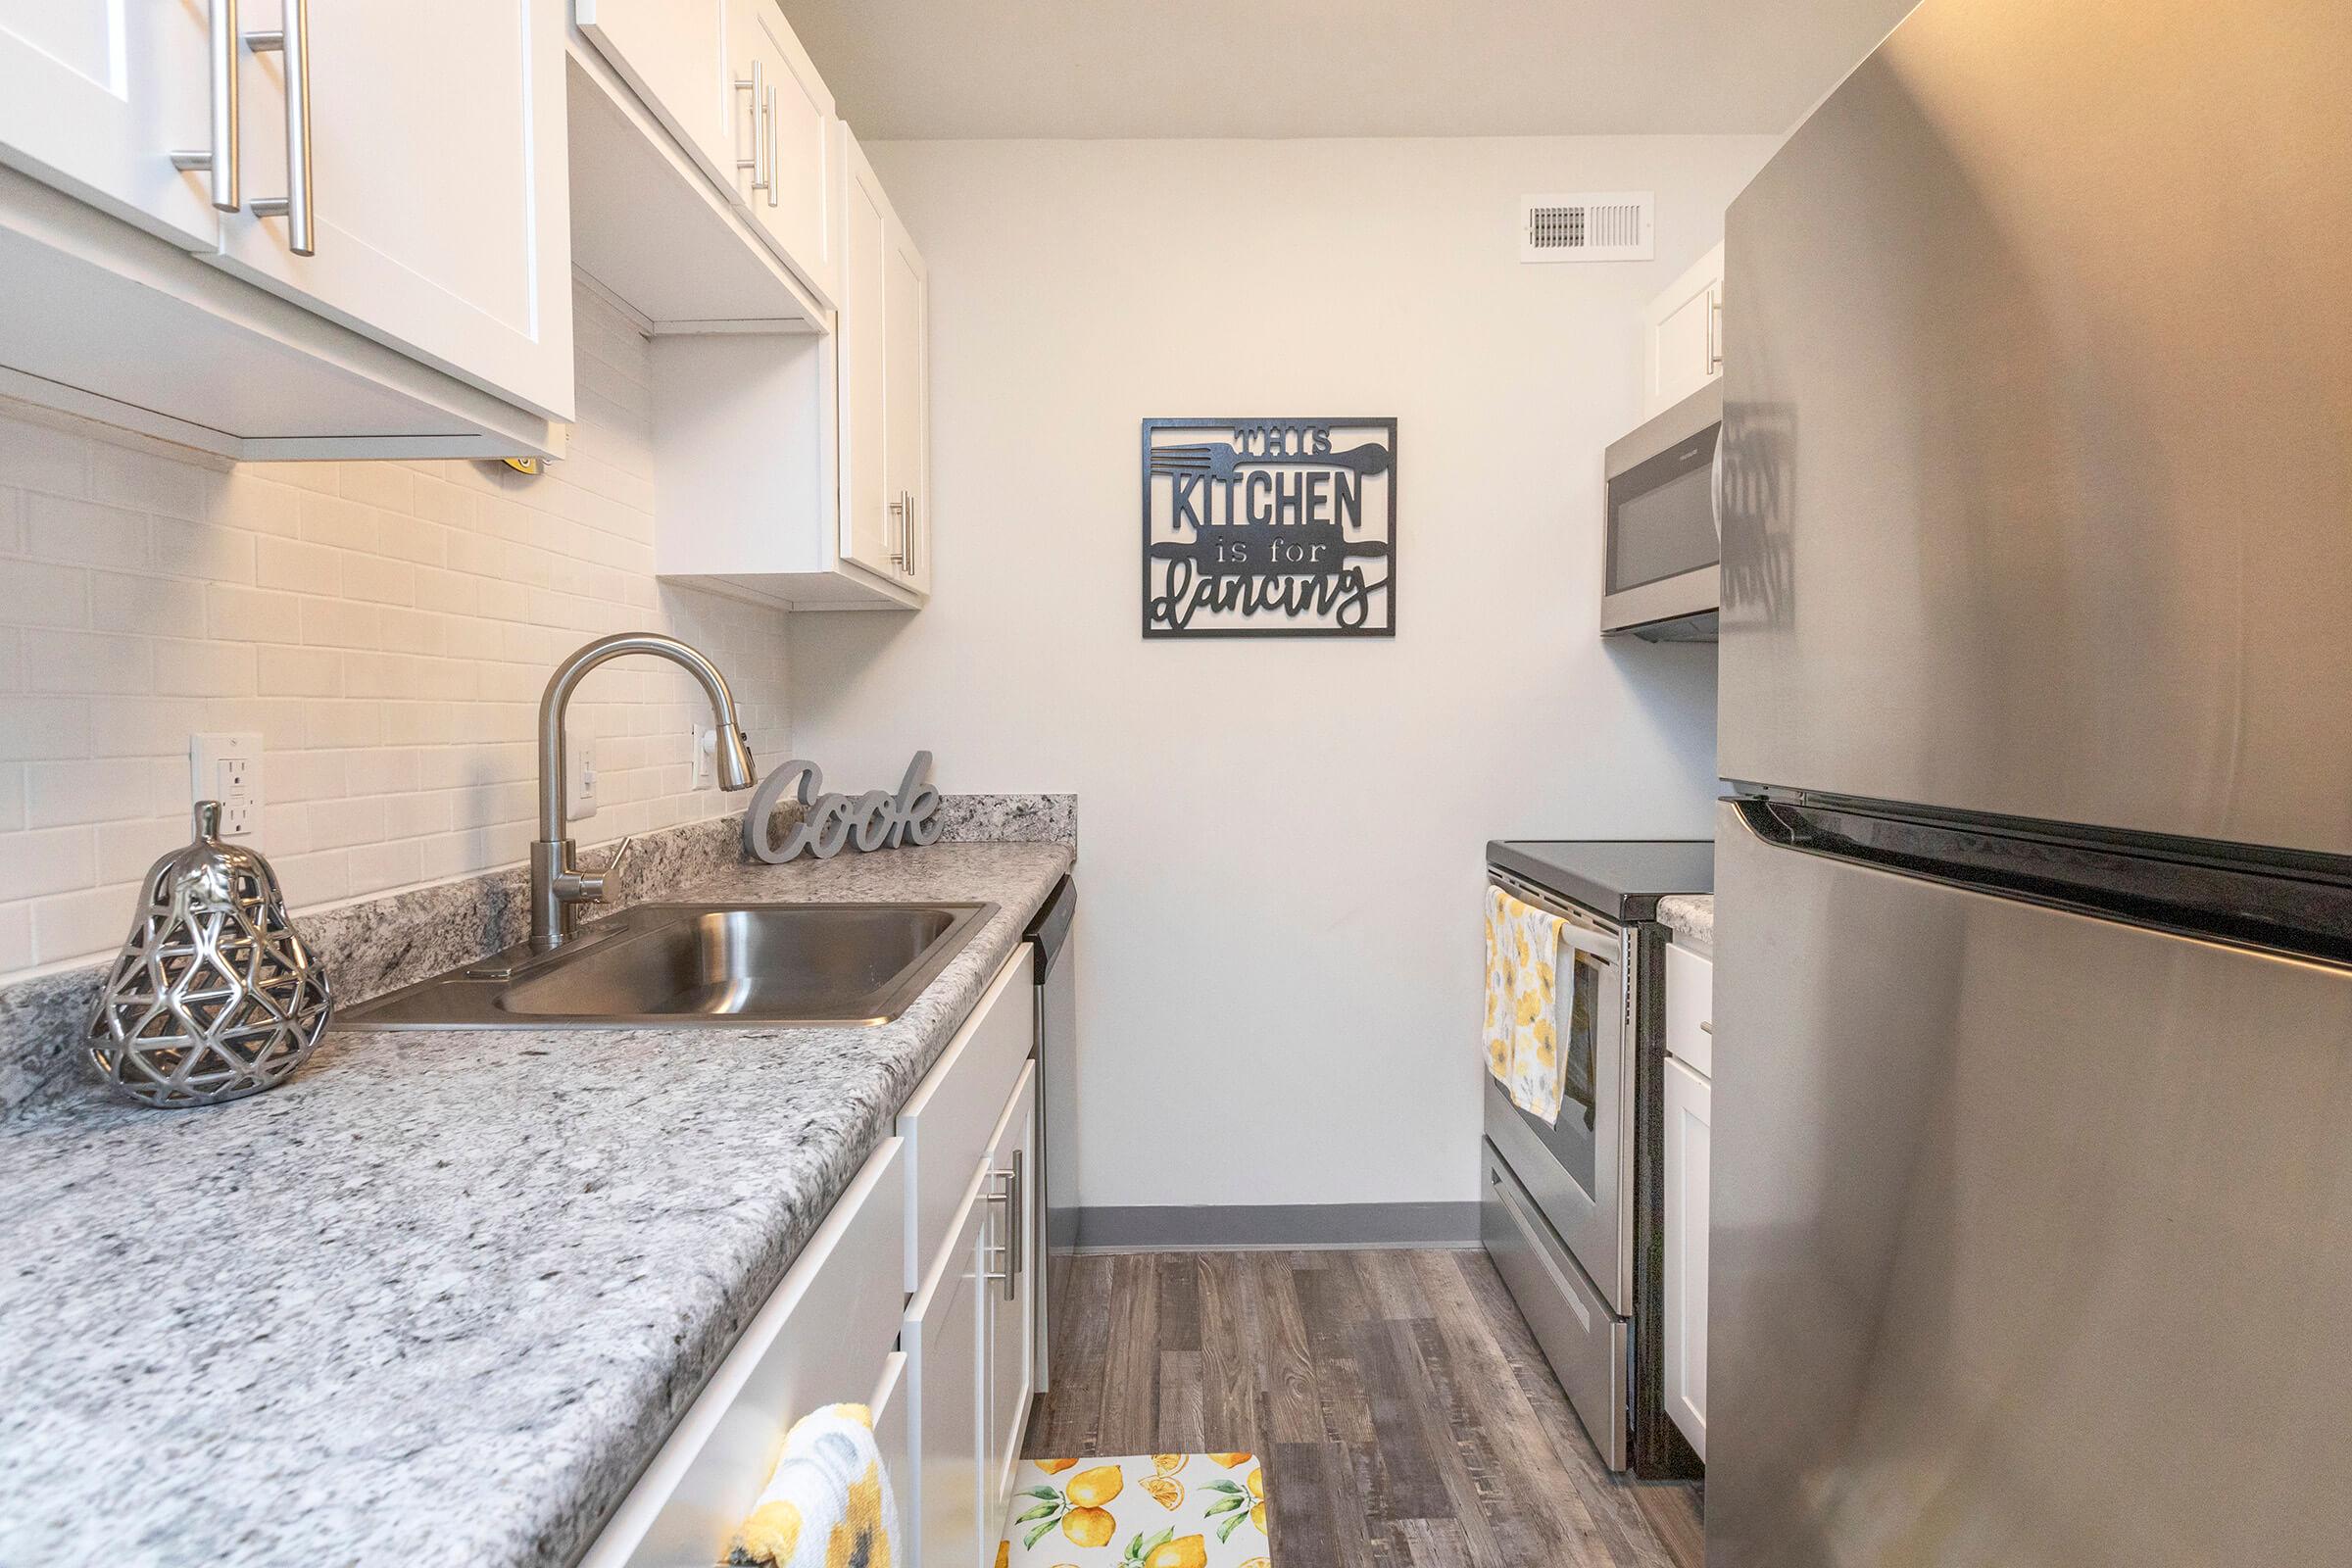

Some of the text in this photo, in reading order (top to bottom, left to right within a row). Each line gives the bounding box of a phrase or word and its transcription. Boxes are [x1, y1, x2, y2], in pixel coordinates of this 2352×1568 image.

[1234, 425, 1332, 457] THIS
[1172, 470, 1362, 528] KITCHEN
[1215, 535, 1327, 563] is for
[1150, 557, 1387, 629] dancing
[743, 750, 945, 864] Cook
